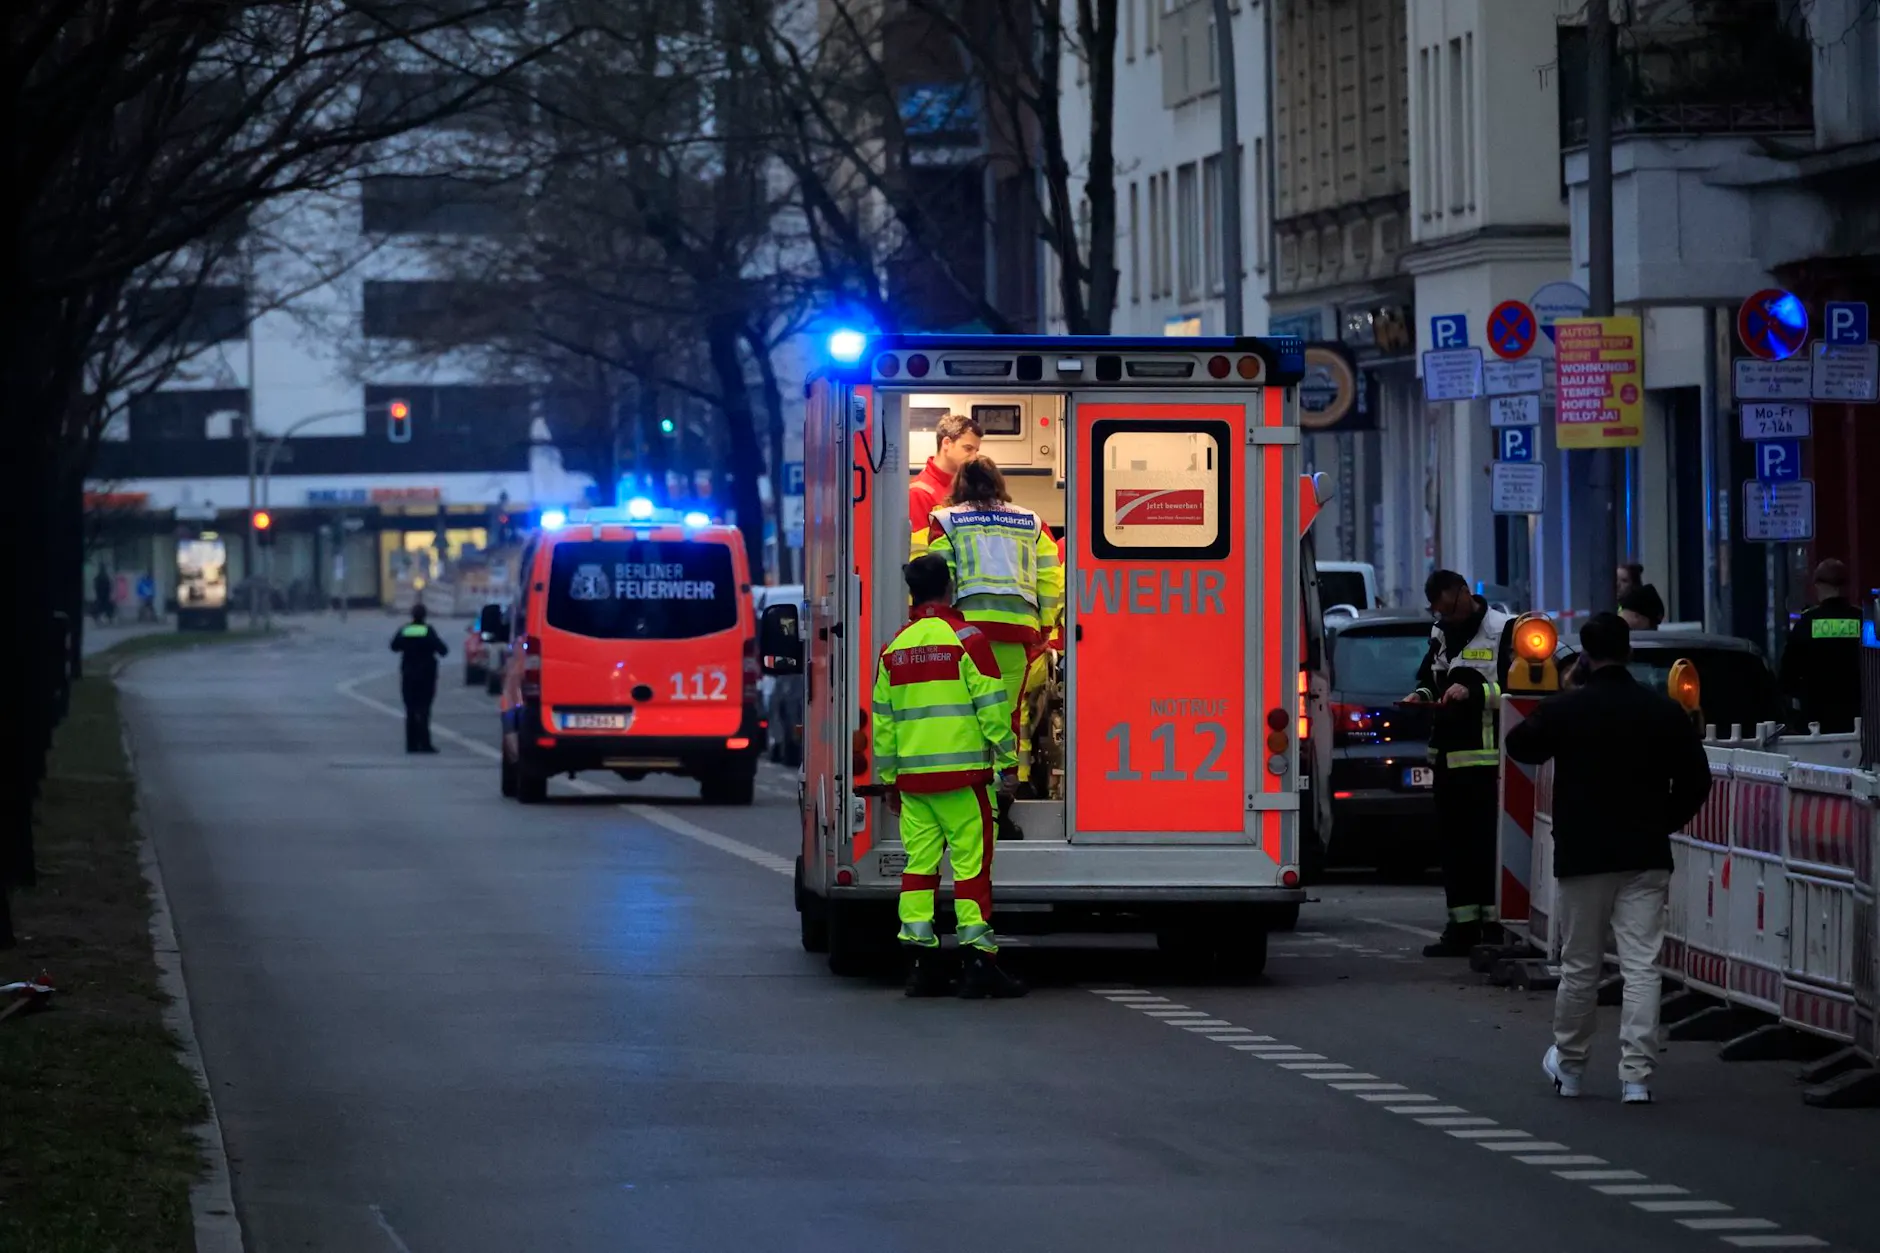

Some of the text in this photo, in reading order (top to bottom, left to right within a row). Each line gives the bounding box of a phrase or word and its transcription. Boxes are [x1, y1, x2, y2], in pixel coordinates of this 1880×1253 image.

[1560, 327, 1599, 337] AUTOS
[1832, 308, 1854, 340] P
[1436, 319, 1457, 347] P
[1561, 375, 1606, 386] BAU AM
[1562, 387, 1611, 398] TEMPEL-
[1562, 399, 1601, 410] HOFER
[1562, 410, 1618, 422] FELD? JA!
[1755, 407, 1794, 419] Mo-Fr
[1759, 419, 1793, 433] 7-14h
[1505, 430, 1524, 458] P
[1764, 444, 1786, 476] P
[1146, 502, 1164, 510] Jetzt
[1165, 502, 1198, 510] bewerben
[951, 514, 1034, 526] Leitende Notärztin
[615, 563, 683, 579] BERLINER
[615, 580, 715, 600] FEUERWEHR
[1077, 569, 1226, 614] WEHR
[1814, 620, 1859, 636] POLZEI
[910, 645, 938, 655] BERLER
[670, 671, 728, 700] 112
[1151, 698, 1230, 717] NOTRUF
[1105, 722, 1229, 781] 112
